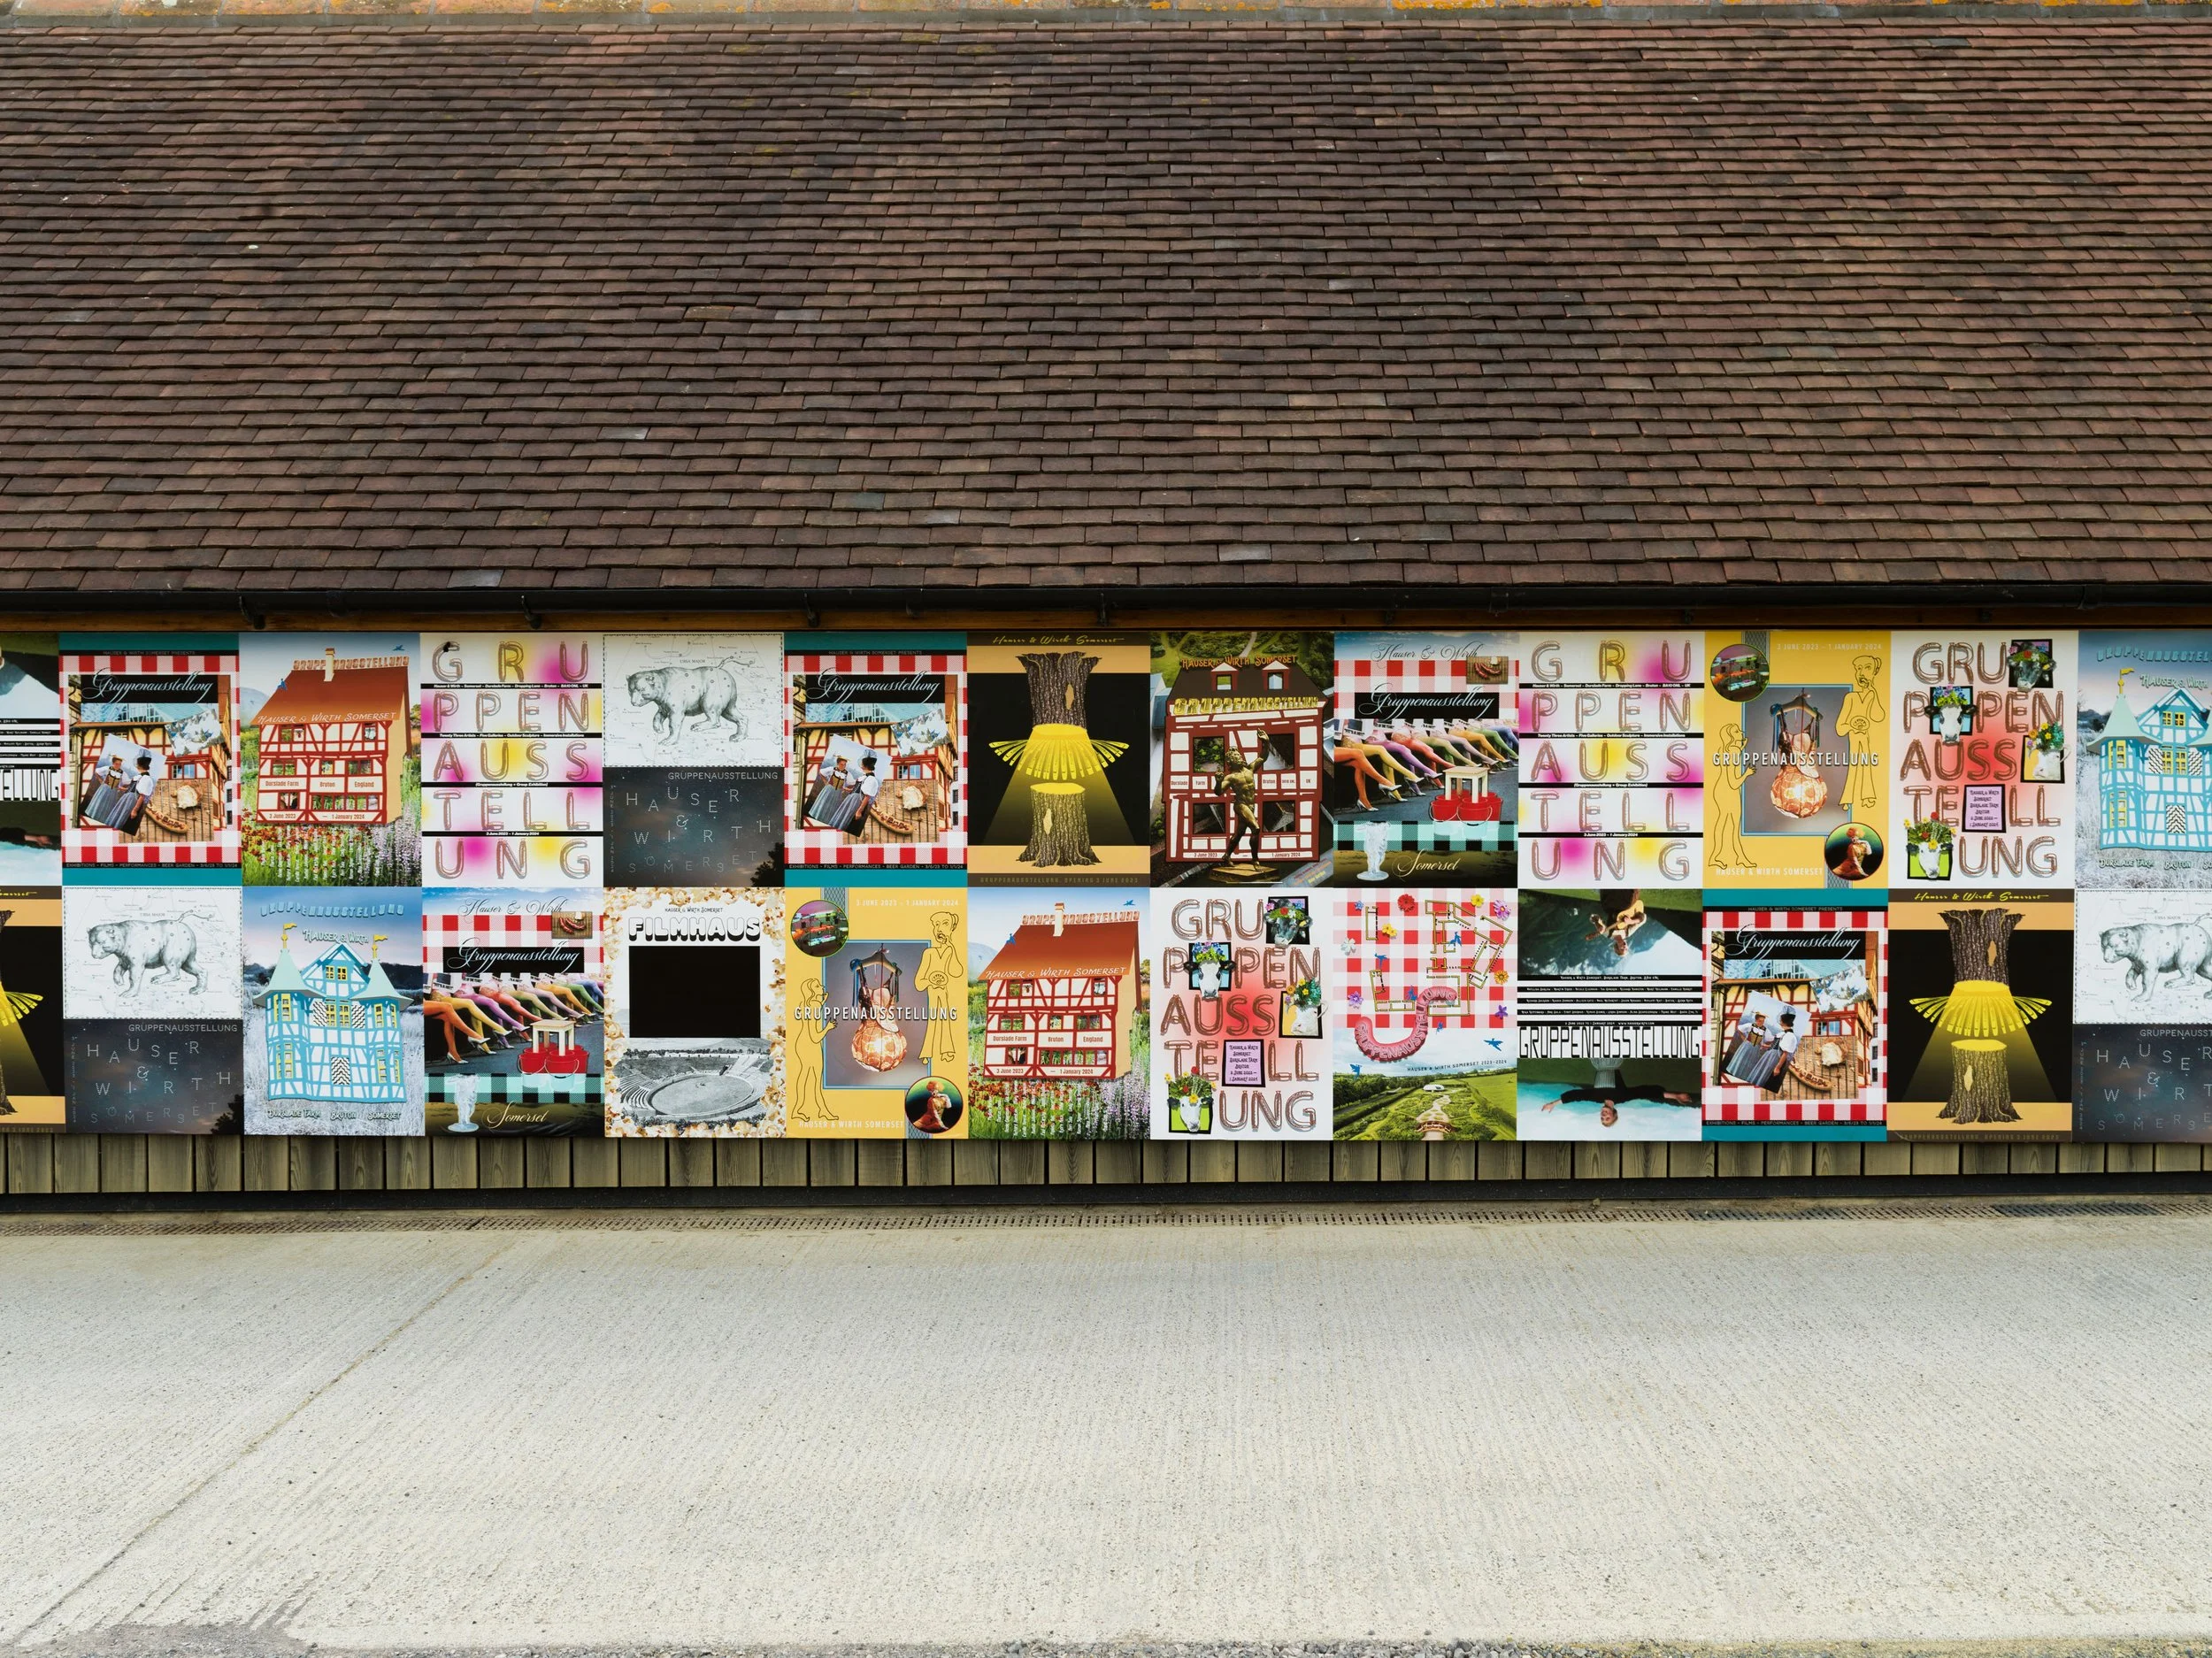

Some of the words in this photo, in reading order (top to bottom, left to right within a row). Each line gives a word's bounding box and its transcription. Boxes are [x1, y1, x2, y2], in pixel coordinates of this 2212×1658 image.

[1041, 634, 1071, 644] Wirth
[1076, 635, 1125, 644] Somerset
[294, 656, 409, 670] GRUPPNAUSSTELLUNG
[1181, 658, 1214, 670] HAUSER
[1225, 656, 1249, 668] WIRTH
[1371, 642, 1416, 669] Hauser
[1421, 645, 1435, 659] &
[1440, 641, 1486, 661] Wirth
[1913, 642, 2008, 683] GRU
[81, 667, 213, 703] Gruppenausstellung
[806, 667, 940, 703] Gruppenausstellung
[2139, 672, 2177, 688] HAUSER
[2186, 675, 2208, 690] WIRTH
[1174, 697, 1318, 715] GRUPPENAUSSTELLUNG
[1358, 682, 1494, 720] Gruppenausstellung
[311, 712, 341, 722] WIRTH
[346, 712, 396, 721] SOMERSET
[1712, 752, 1879, 766] GRUPPENAUSSTELLUNG
[1901, 739, 2016, 780] AUSS
[676, 815, 688, 827] &
[1392, 848, 1461, 879] Somerset
[1960, 836, 2056, 878] UNG
[1963, 892, 1994, 901] Wirth
[2000, 892, 2049, 901] Somerset
[457, 898, 501, 924] Hauser
[507, 900, 520, 914] &
[526, 895, 568, 916] Wirth
[1023, 911, 1140, 925] GRUPPNAUSSTELLUNG
[1171, 898, 1263, 939] GRU
[303, 929, 340, 944] HAUSER
[348, 932, 368, 945] WIRTH
[628, 917, 761, 941] FILMHAUS
[1724, 924, 1860, 960] Gruppenausstellung
[447, 937, 580, 975] Gruppenausstellung
[1041, 967, 1070, 977] WIRTH
[1076, 967, 1127, 976] SOMERSET
[795, 1007, 957, 1021] GRUPPENAUSSTELLUNG
[1160, 994, 1275, 1035] AUSS
[1356, 987, 1457, 1060] GRUPPENAUSSTELLUNG
[1518, 1025, 1700, 1059] GRUPPENAUSSTELLUNG
[137, 1066, 150, 1078] &
[2147, 1072, 2160, 1085] &
[330, 1110, 357, 1120] BRUTON
[367, 1111, 401, 1120] SOMERSET
[481, 1101, 549, 1133] Somerset
[1220, 1090, 1315, 1131] UNG
